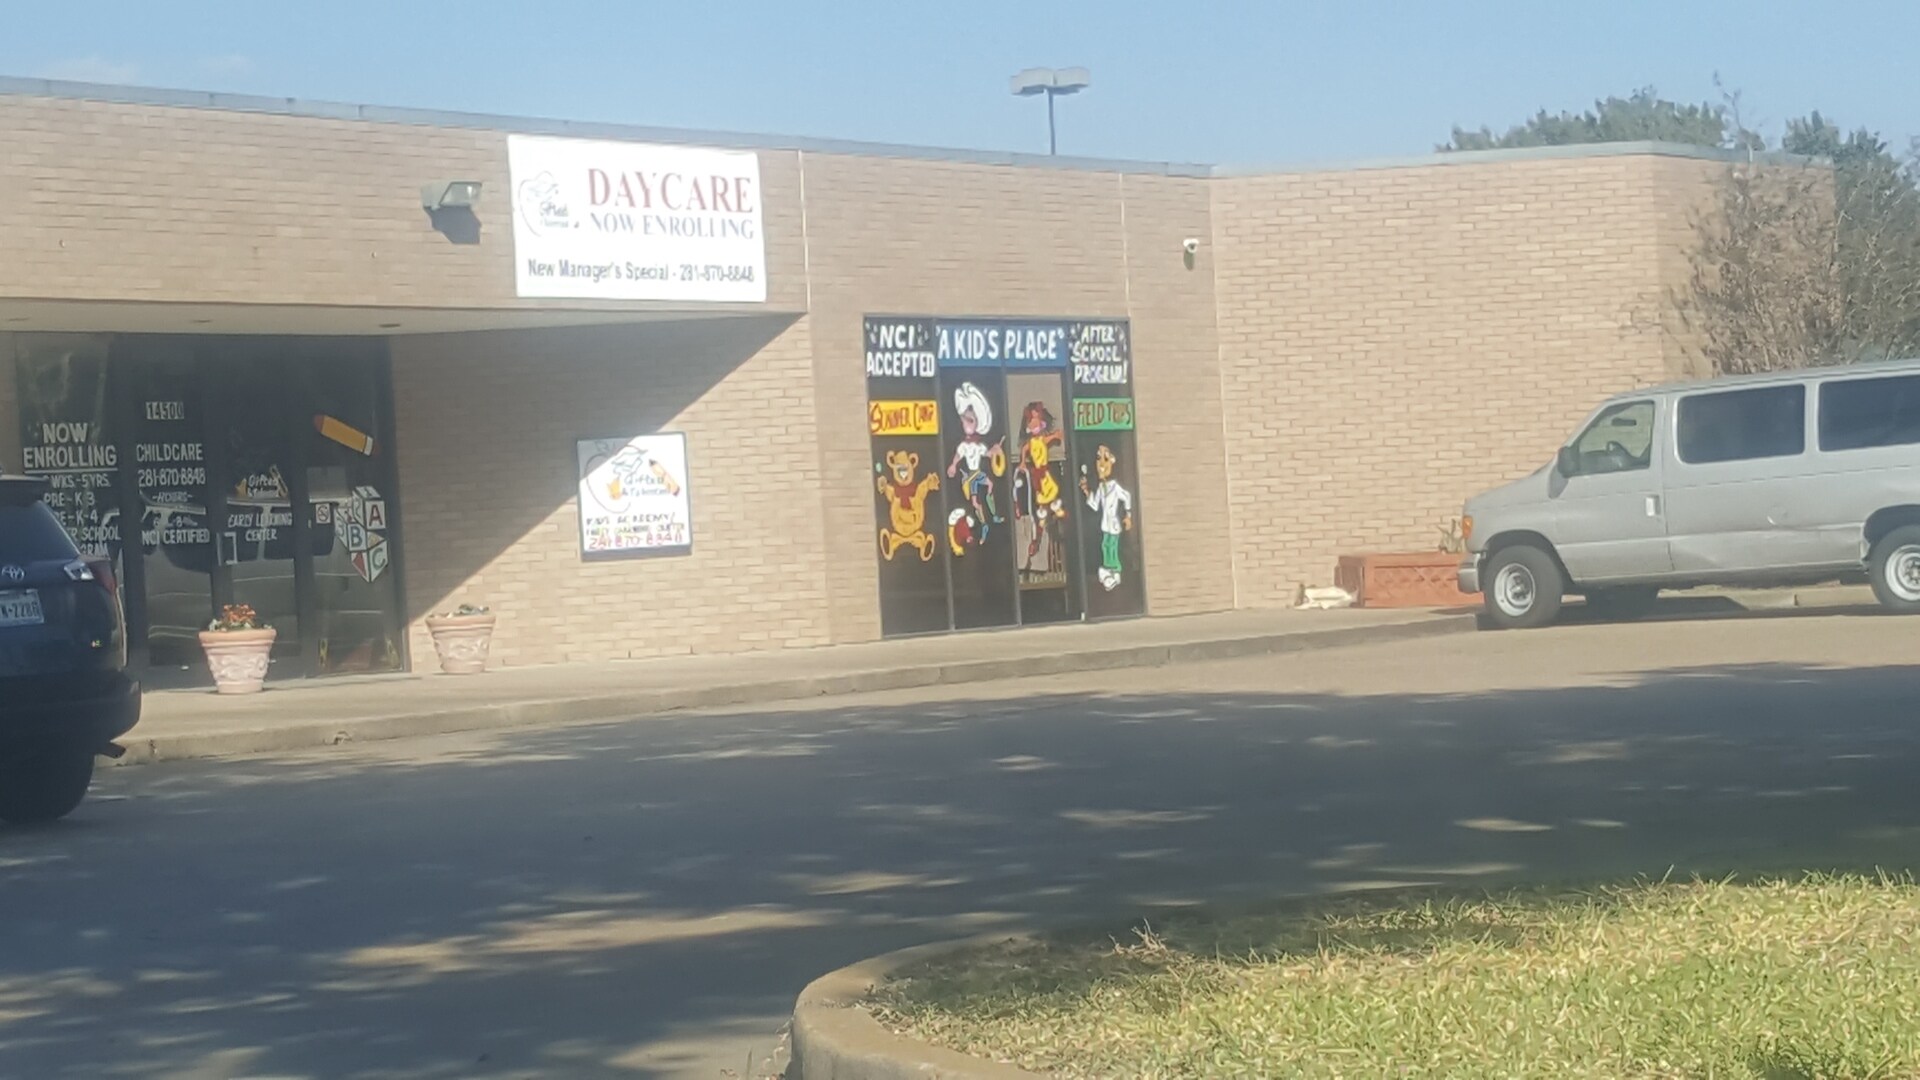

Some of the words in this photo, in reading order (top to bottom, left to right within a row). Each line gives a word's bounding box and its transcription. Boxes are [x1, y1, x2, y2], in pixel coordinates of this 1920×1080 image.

[588, 168, 753, 213] DAYCARE
[590, 212, 635, 233] NOW
[643, 214, 754, 239] ENROLLING
[528, 258, 555, 277] New
[559, 260, 622, 283] Manager's
[626, 262, 669, 282] Special
[880, 325, 915, 349] NCI
[954, 328, 1000, 360] KID'S
[1081, 325, 1116, 343] AFTER
[866, 351, 935, 378] ACCEPTED
[1077, 402, 1105, 427] FIELD
[42, 423, 88, 443] NOW
[23, 444, 117, 468] ENROLLING
[136, 443, 203, 462] CHILDCARE
[369, 503, 383, 527] A
[81, 525, 121, 541] SCHOOL
[351, 525, 363, 548] B
